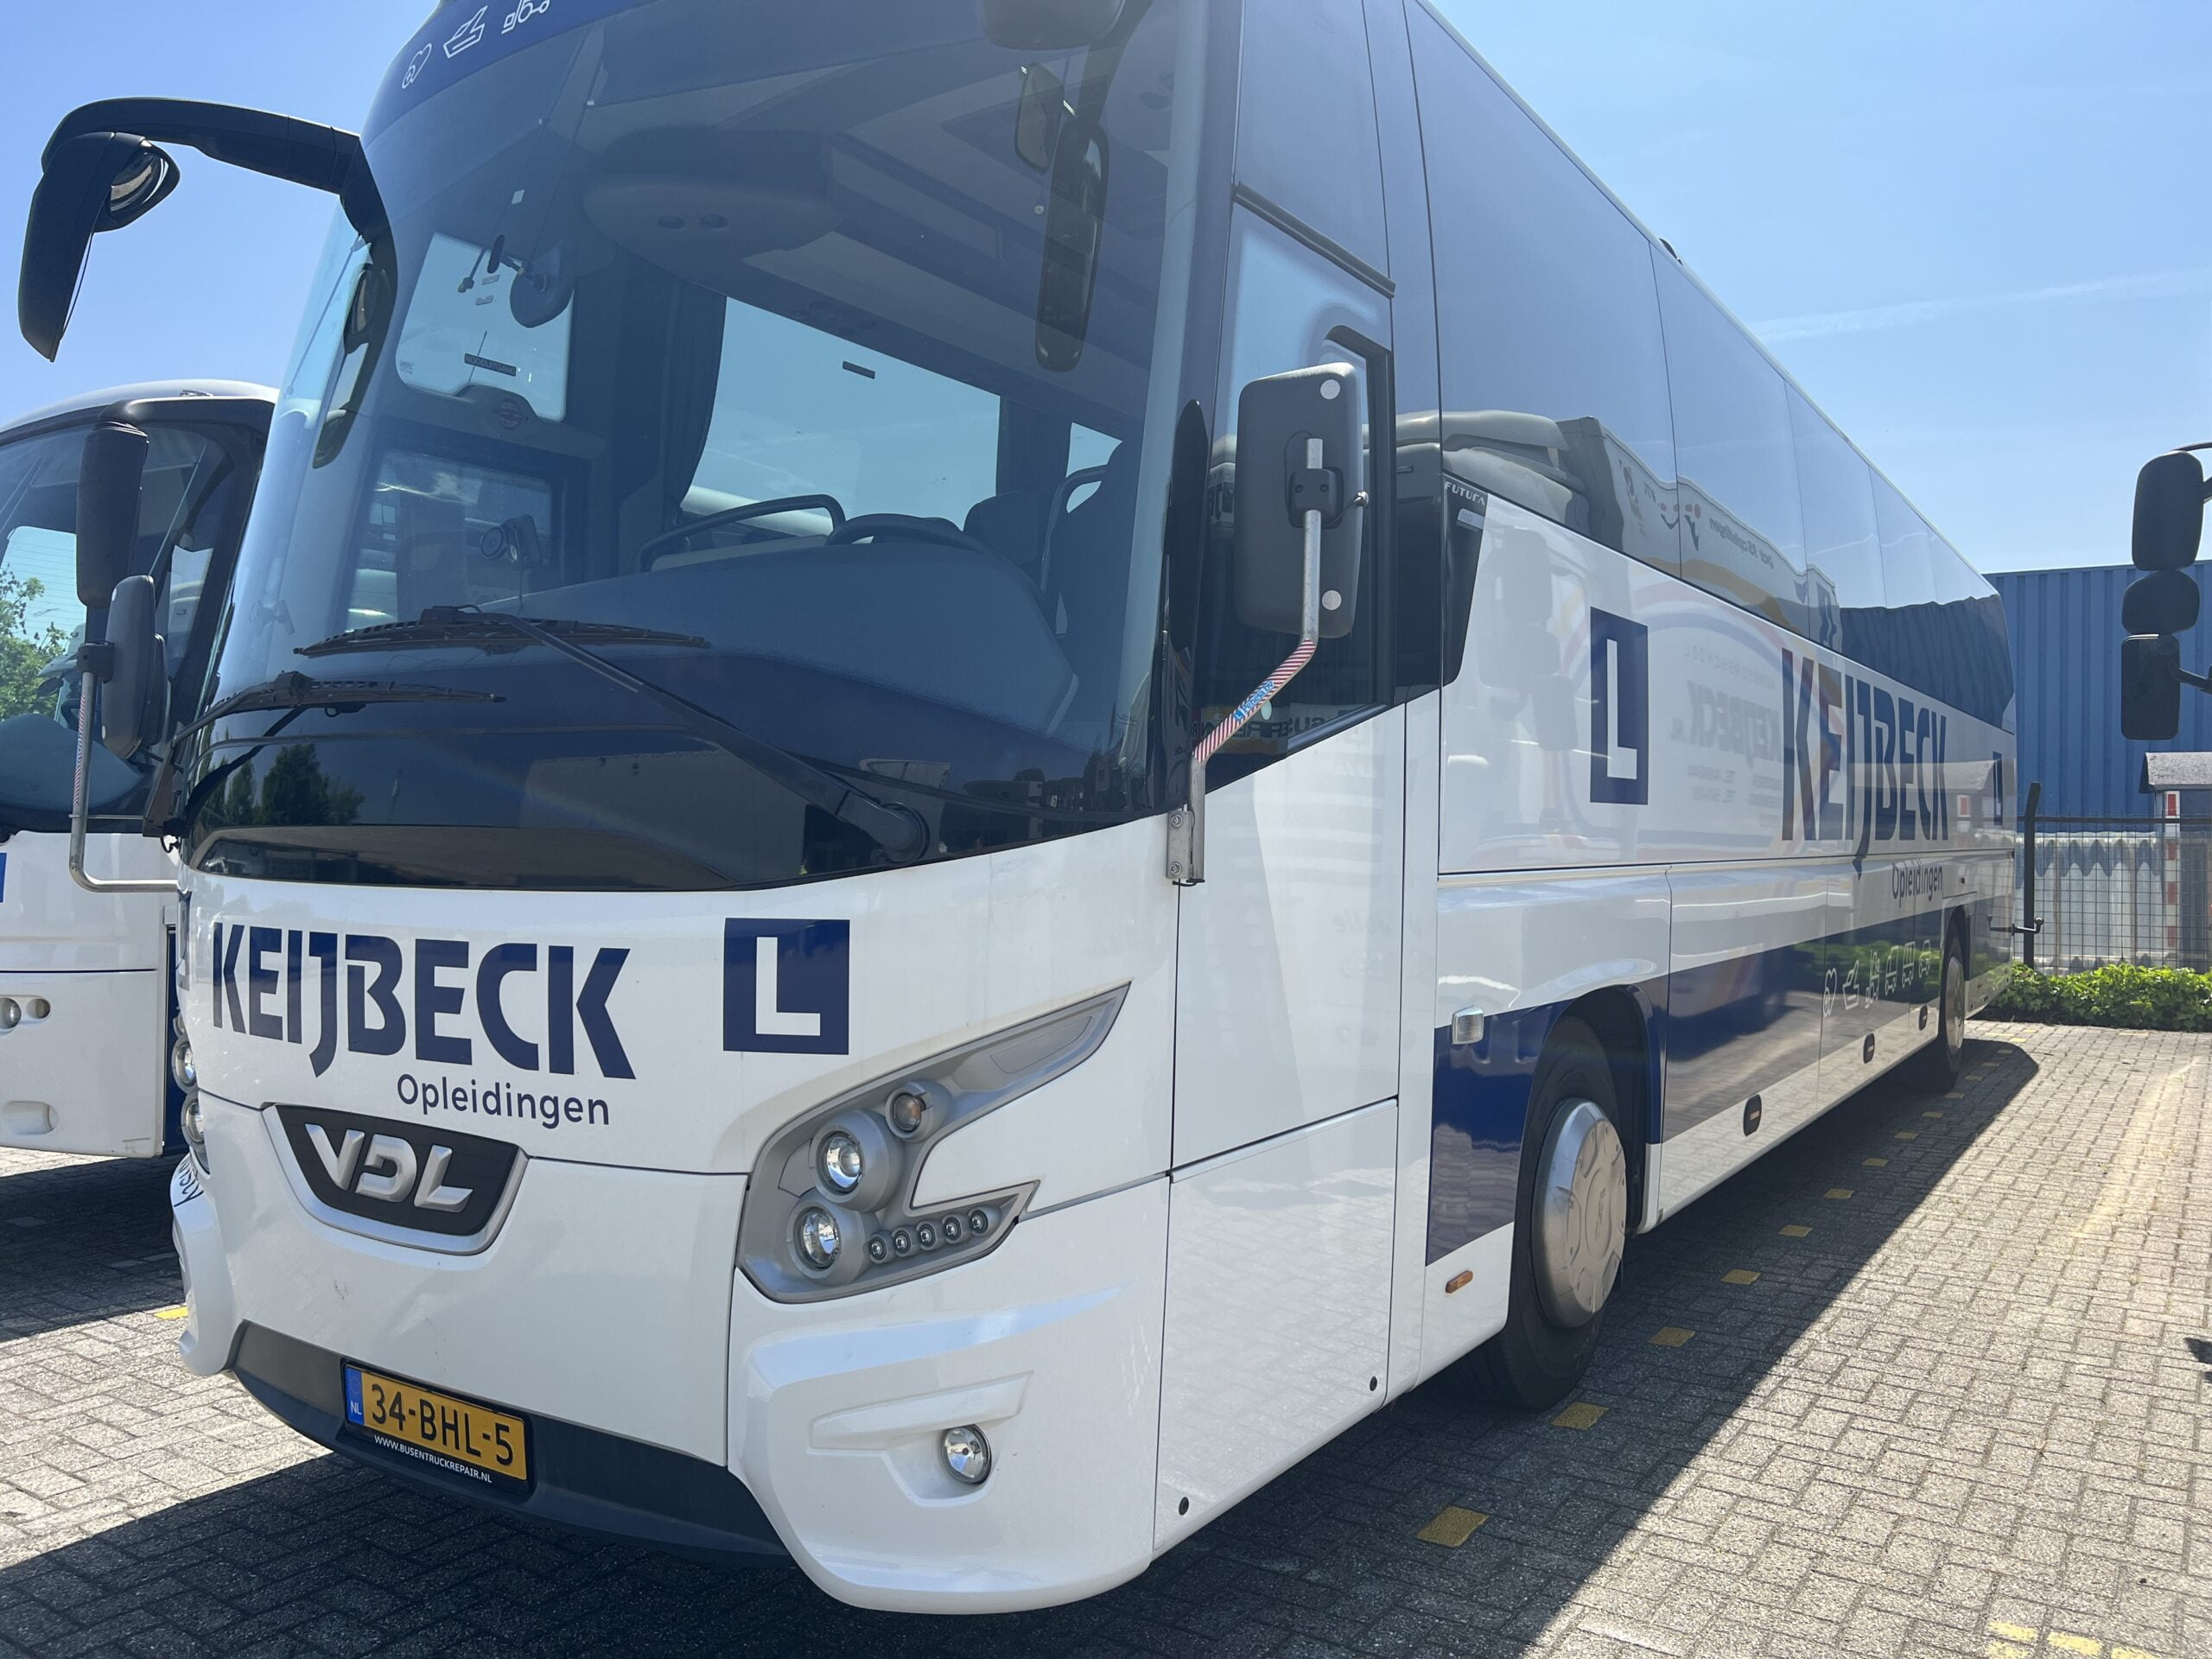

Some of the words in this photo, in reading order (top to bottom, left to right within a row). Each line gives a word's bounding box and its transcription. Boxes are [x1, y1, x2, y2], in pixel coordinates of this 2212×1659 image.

[1444, 480, 1485, 505] FUTURA
[1782, 647, 1948, 880] KEIJBECK
[213, 921, 637, 1080] KEIJBECK
[755, 936, 821, 1037] L
[397, 1074, 610, 1129] Opleidingen
[304, 1122, 474, 1213] VDL
[350, 1401, 362, 1415] NL
[372, 1384, 513, 1465] 34-BHL-5
[374, 1434, 493, 1484] WWW.BUSENTRUCKREPAIR.NL
